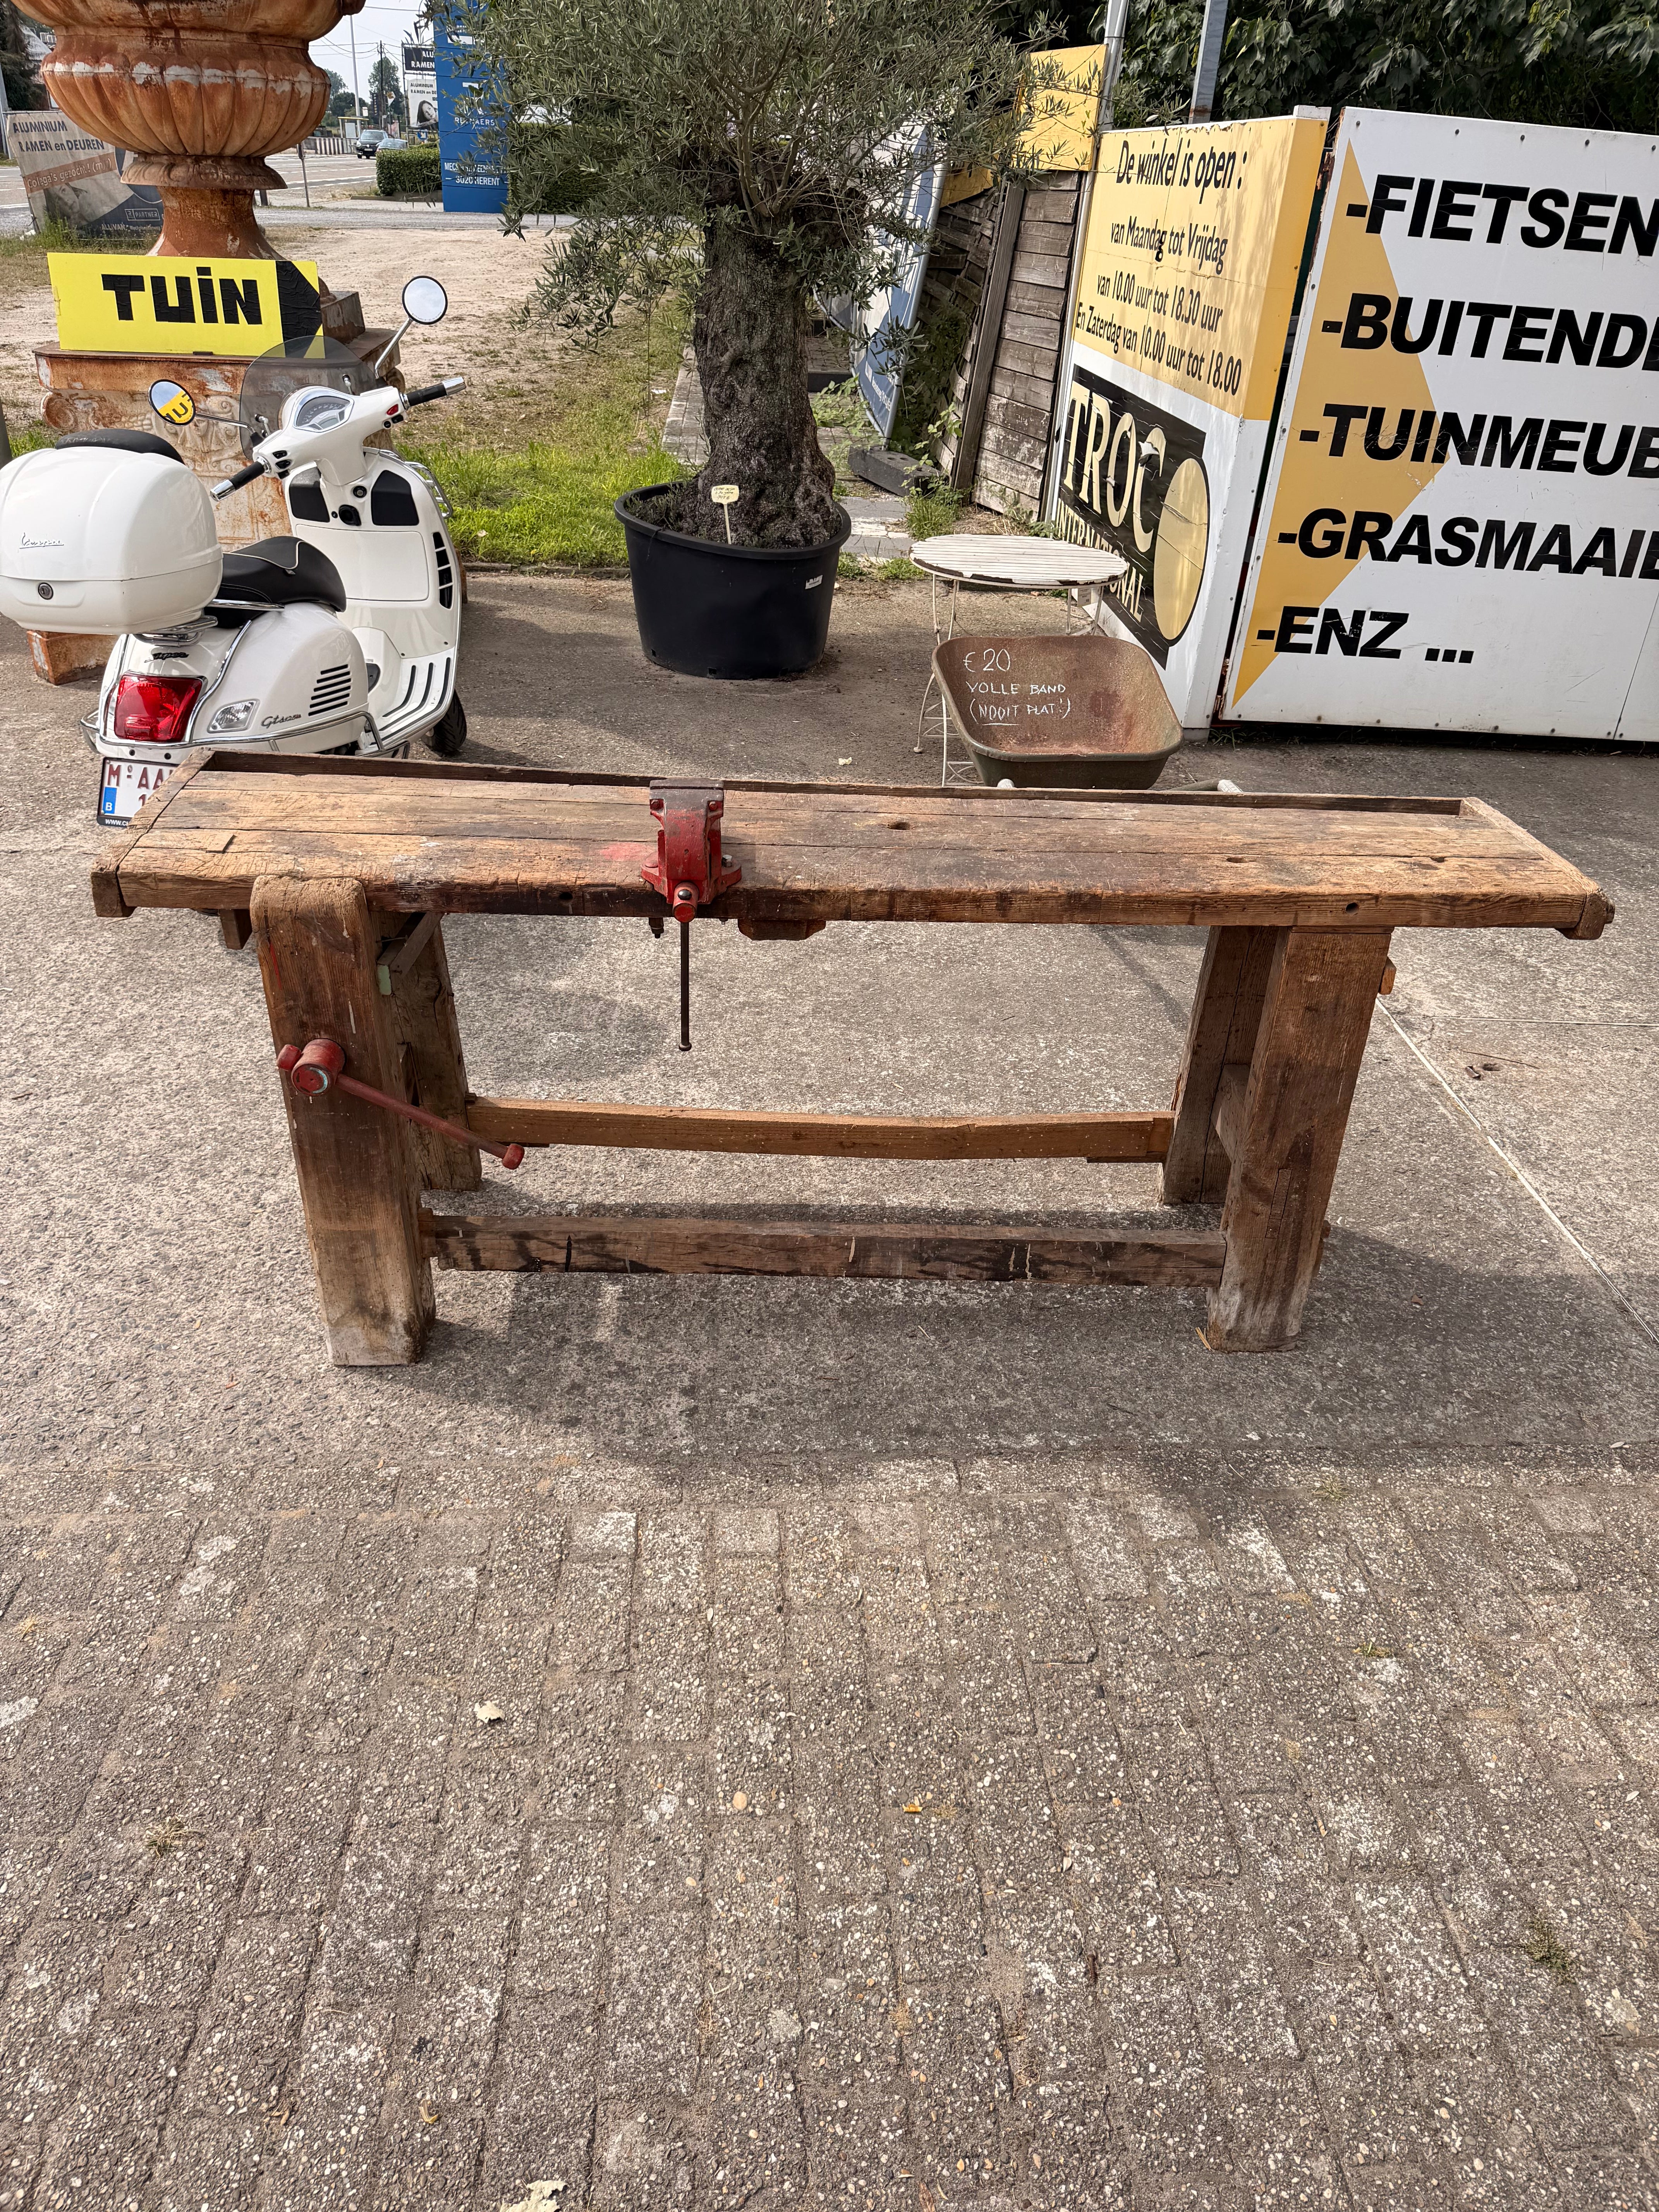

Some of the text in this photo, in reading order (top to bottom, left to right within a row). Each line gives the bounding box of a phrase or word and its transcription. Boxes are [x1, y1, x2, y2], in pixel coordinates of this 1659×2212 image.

[13, 120, 67, 133] ALUMINIUM
[18, 139, 105, 152] RAMEN en DEUREN
[474, 177, 500, 186] HERENT
[1116, 140, 1135, 184] De
[1137, 137, 1183, 186] winkel
[1179, 139, 1194, 187] is
[1195, 146, 1236, 204] open
[1346, 174, 1659, 257] -FIETSEN
[1111, 216, 1228, 275] van Maandag tot Vrijdag
[1097, 270, 1223, 333] van 10.00 uur tot 18.30 uur
[1076, 302, 1242, 396] En Zaterdag van 10.00 uur tot 18.00
[1064, 381, 1166, 553] TROC
[1257, 606, 1409, 658] -ENZ
[963, 649, 1010, 672] € 20
[966, 682, 1066, 694] VOLLE BAND
[106, 802, 112, 811] B
